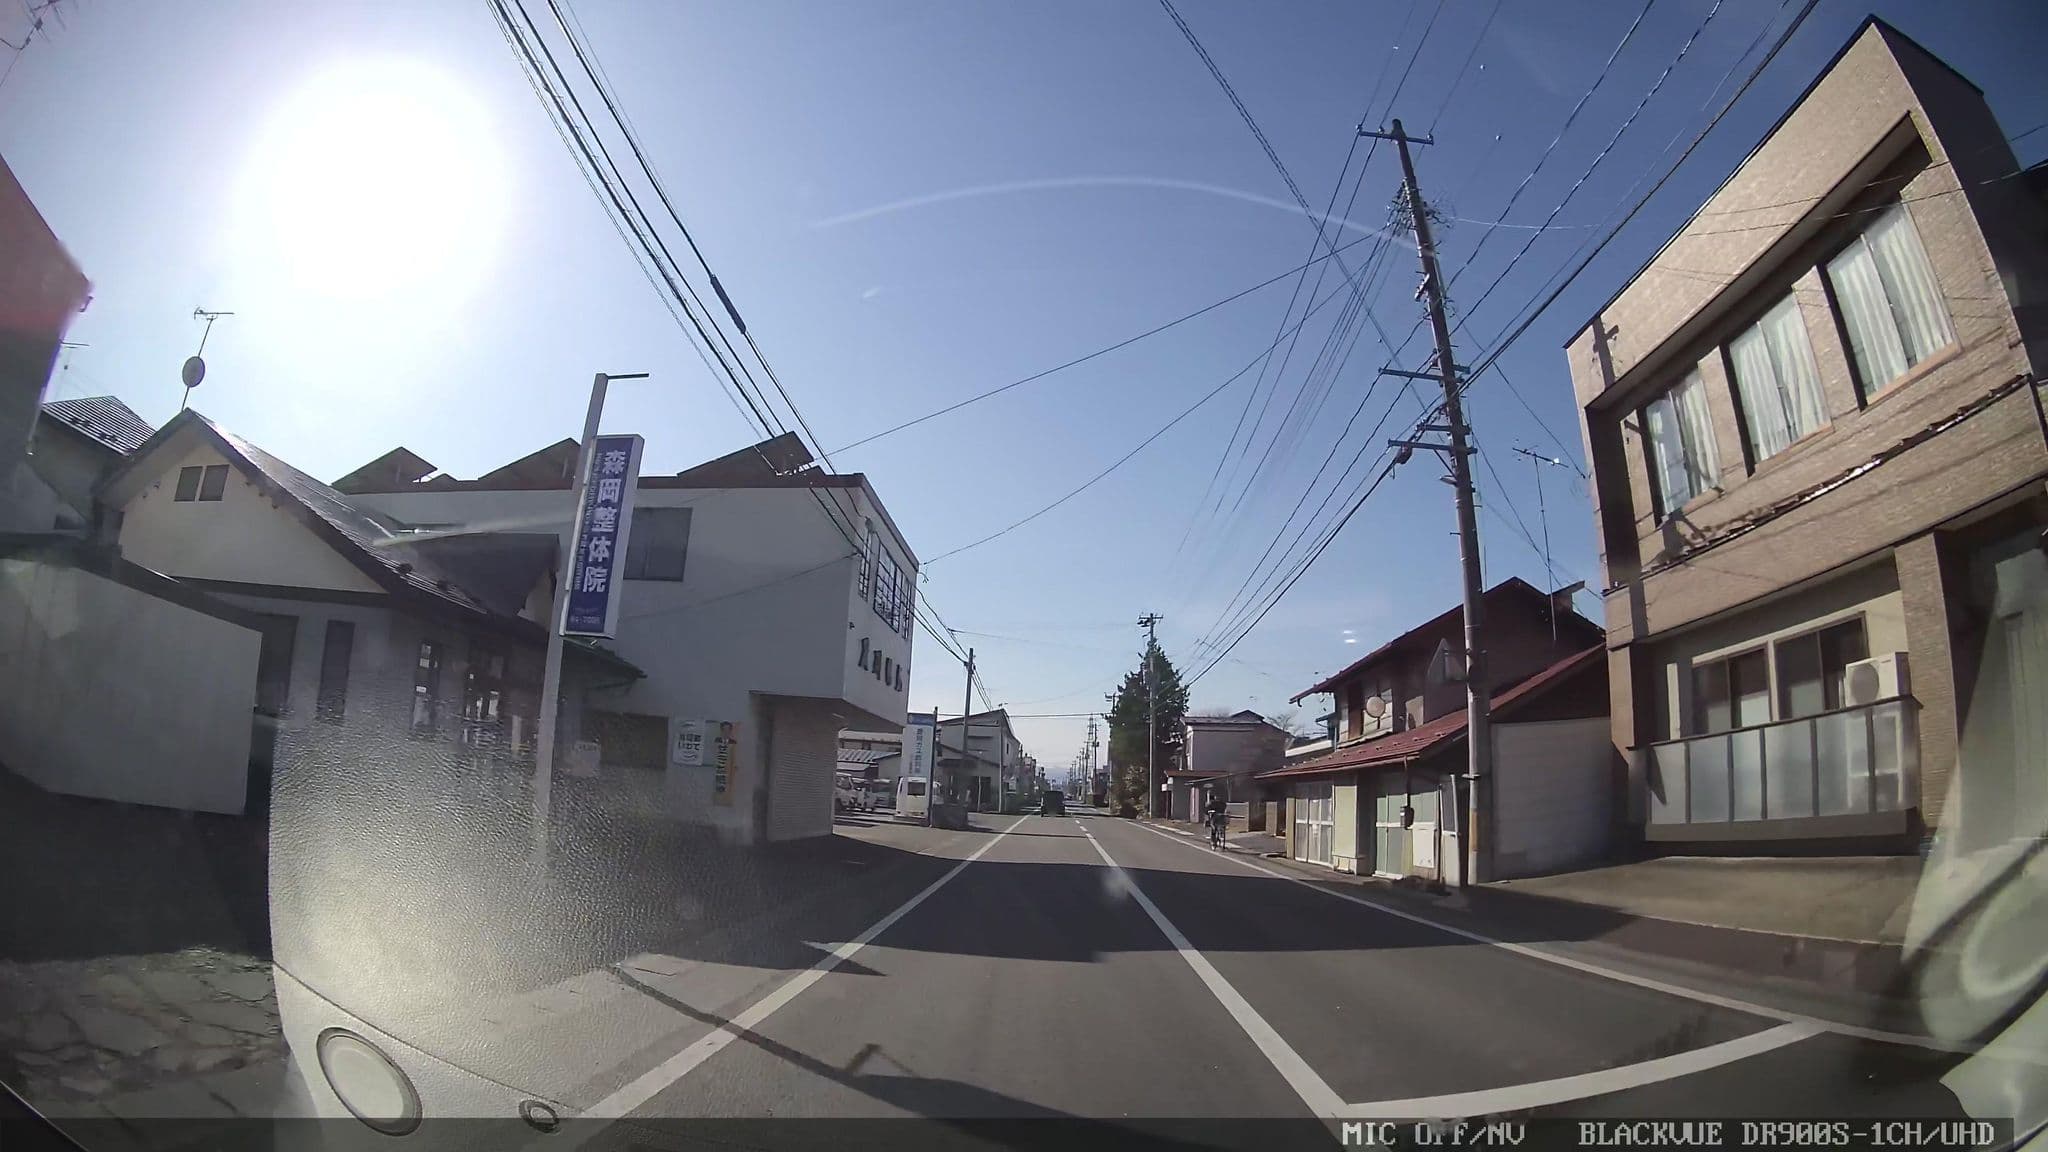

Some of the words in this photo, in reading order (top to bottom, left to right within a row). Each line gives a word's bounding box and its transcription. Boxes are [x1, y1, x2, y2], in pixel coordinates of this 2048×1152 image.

[582, 450, 626, 593] 森岡整体院
